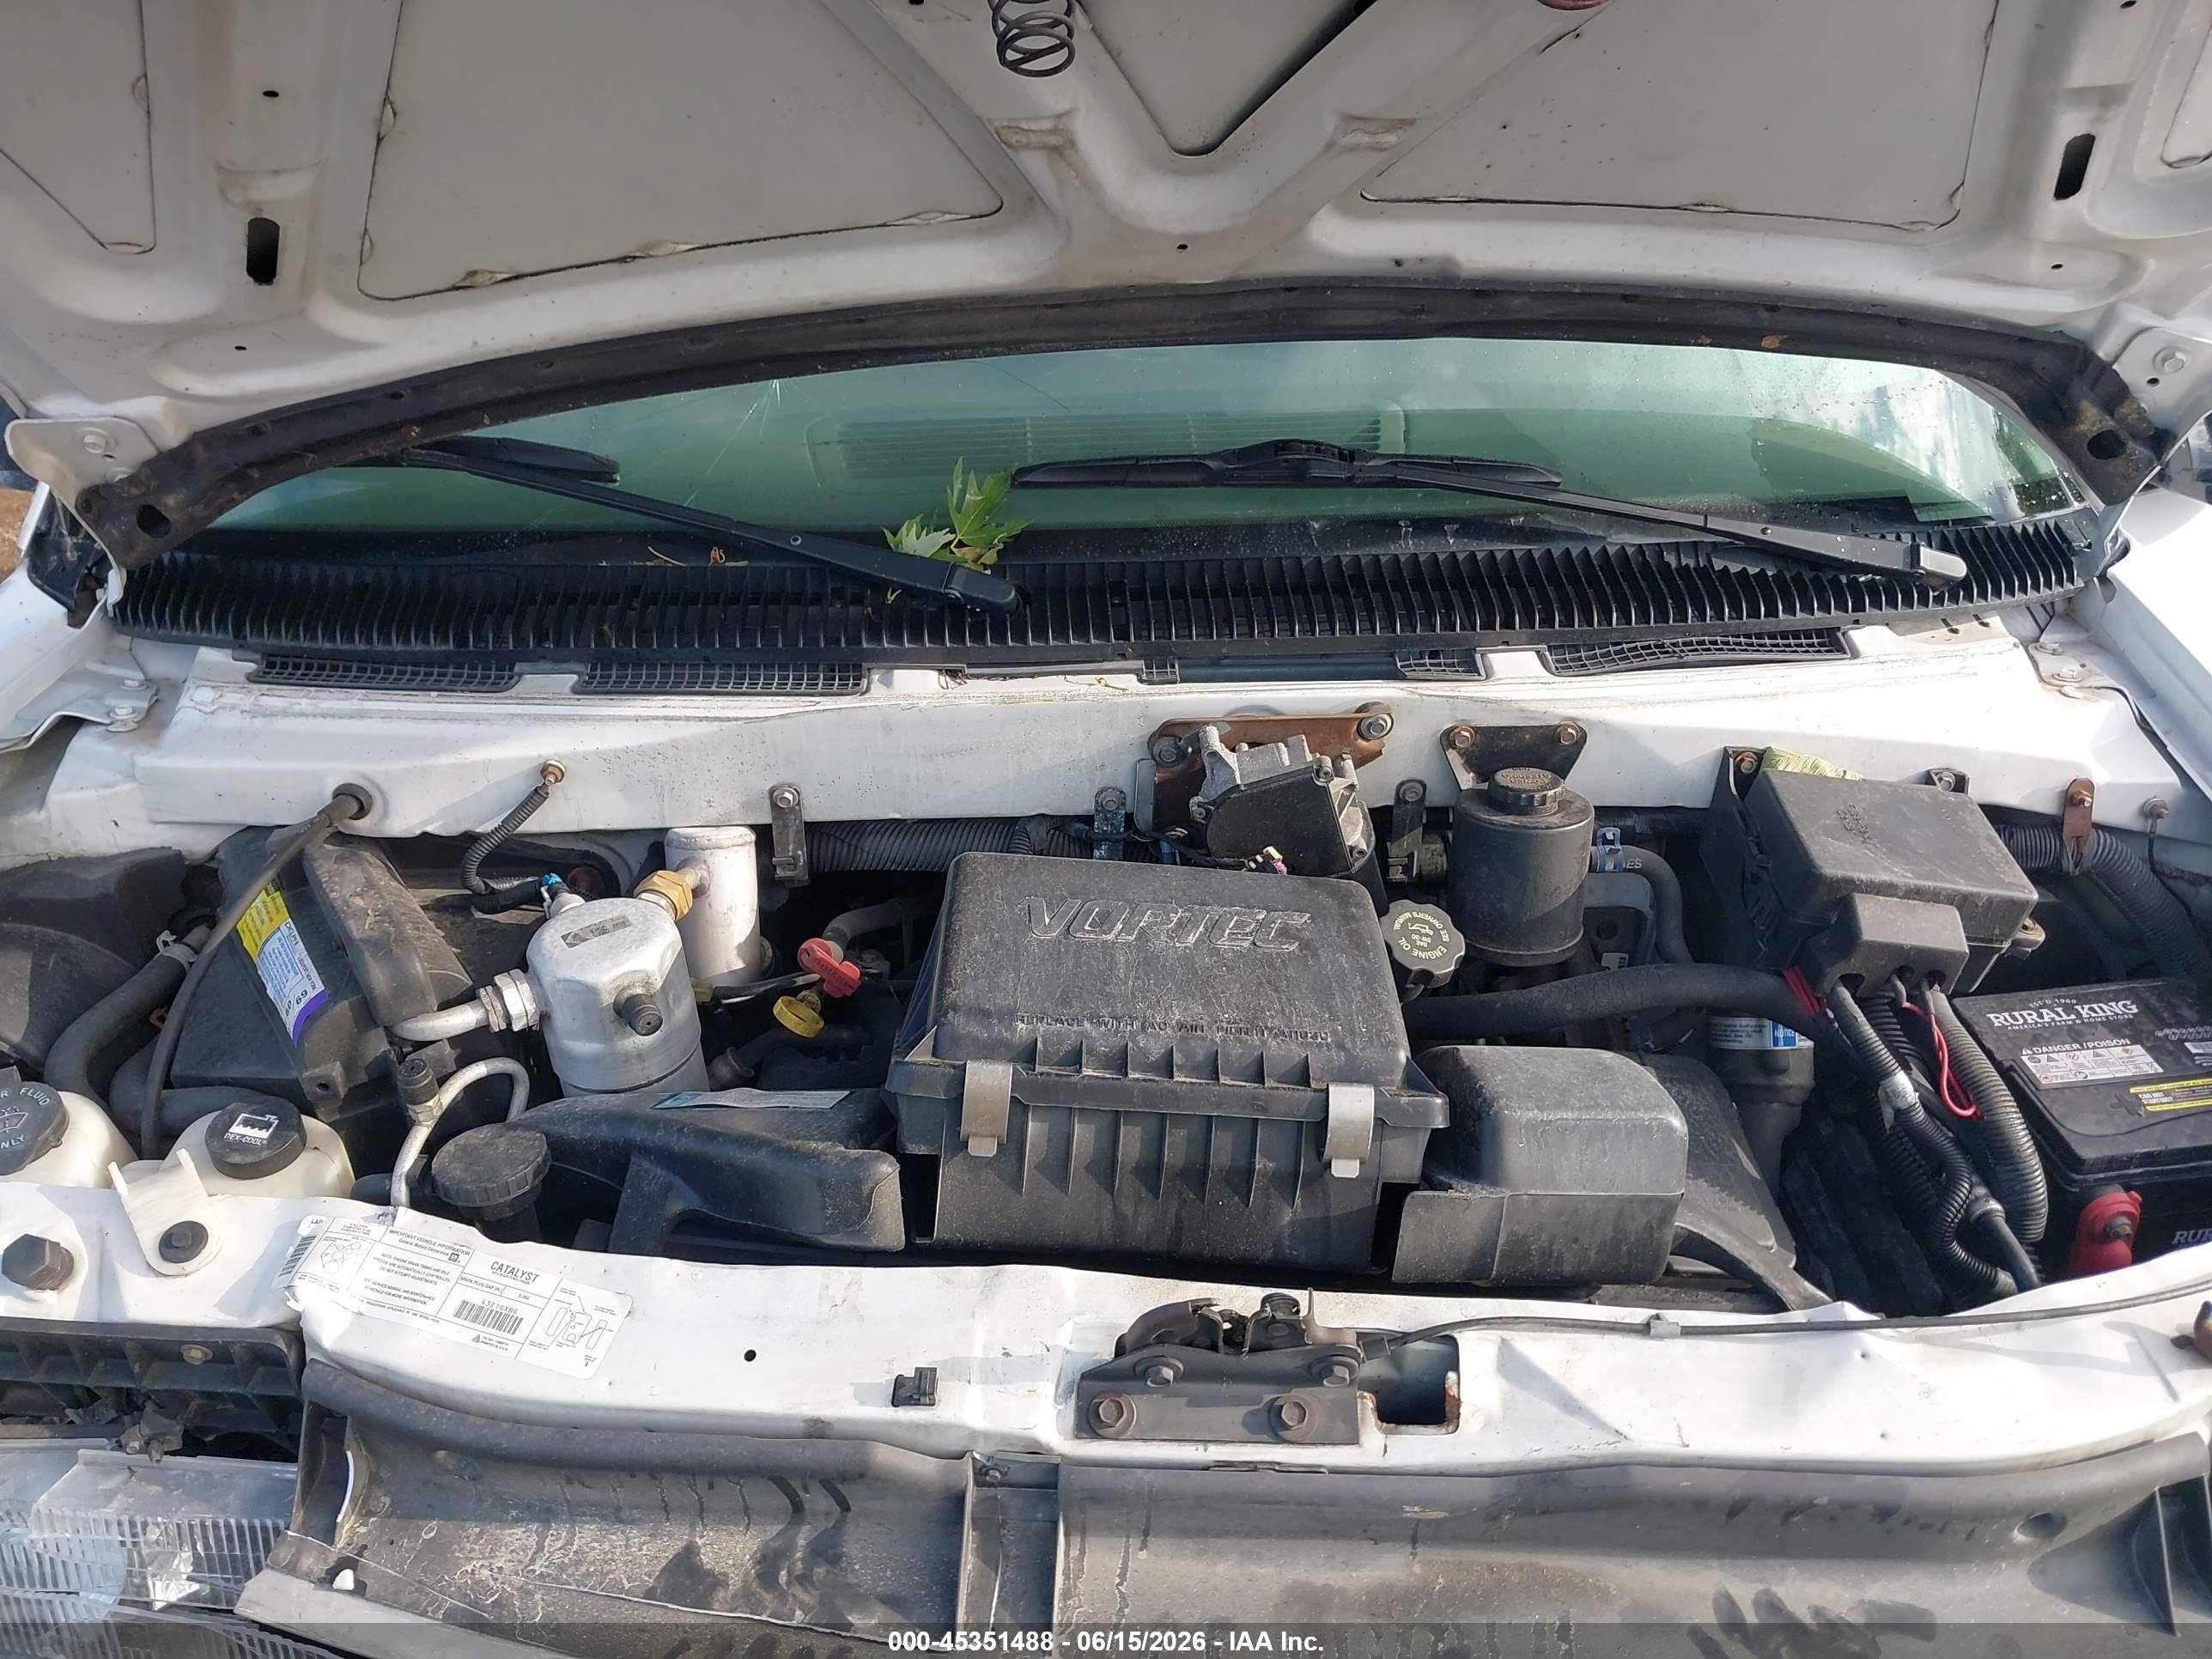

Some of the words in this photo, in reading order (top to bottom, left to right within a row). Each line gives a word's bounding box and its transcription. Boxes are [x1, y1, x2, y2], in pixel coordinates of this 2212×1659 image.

[1027, 897, 1312, 952] VORTEC
[1394, 912, 1412, 931] MANUAL
[1440, 929, 1449, 942] SEE
[1398, 937, 1411, 951] OIL
[1412, 945, 1447, 959] ENGINE
[1986, 1008, 2076, 1027] RURAL
[2074, 1000, 2139, 1018] KING
[1774, 1029, 1796, 1038] NOTICE
[2033, 1043, 2081, 1054] DANGER
[20, 1088, 50, 1106] FLUID
[490, 1261, 540, 1282] CATALYST
